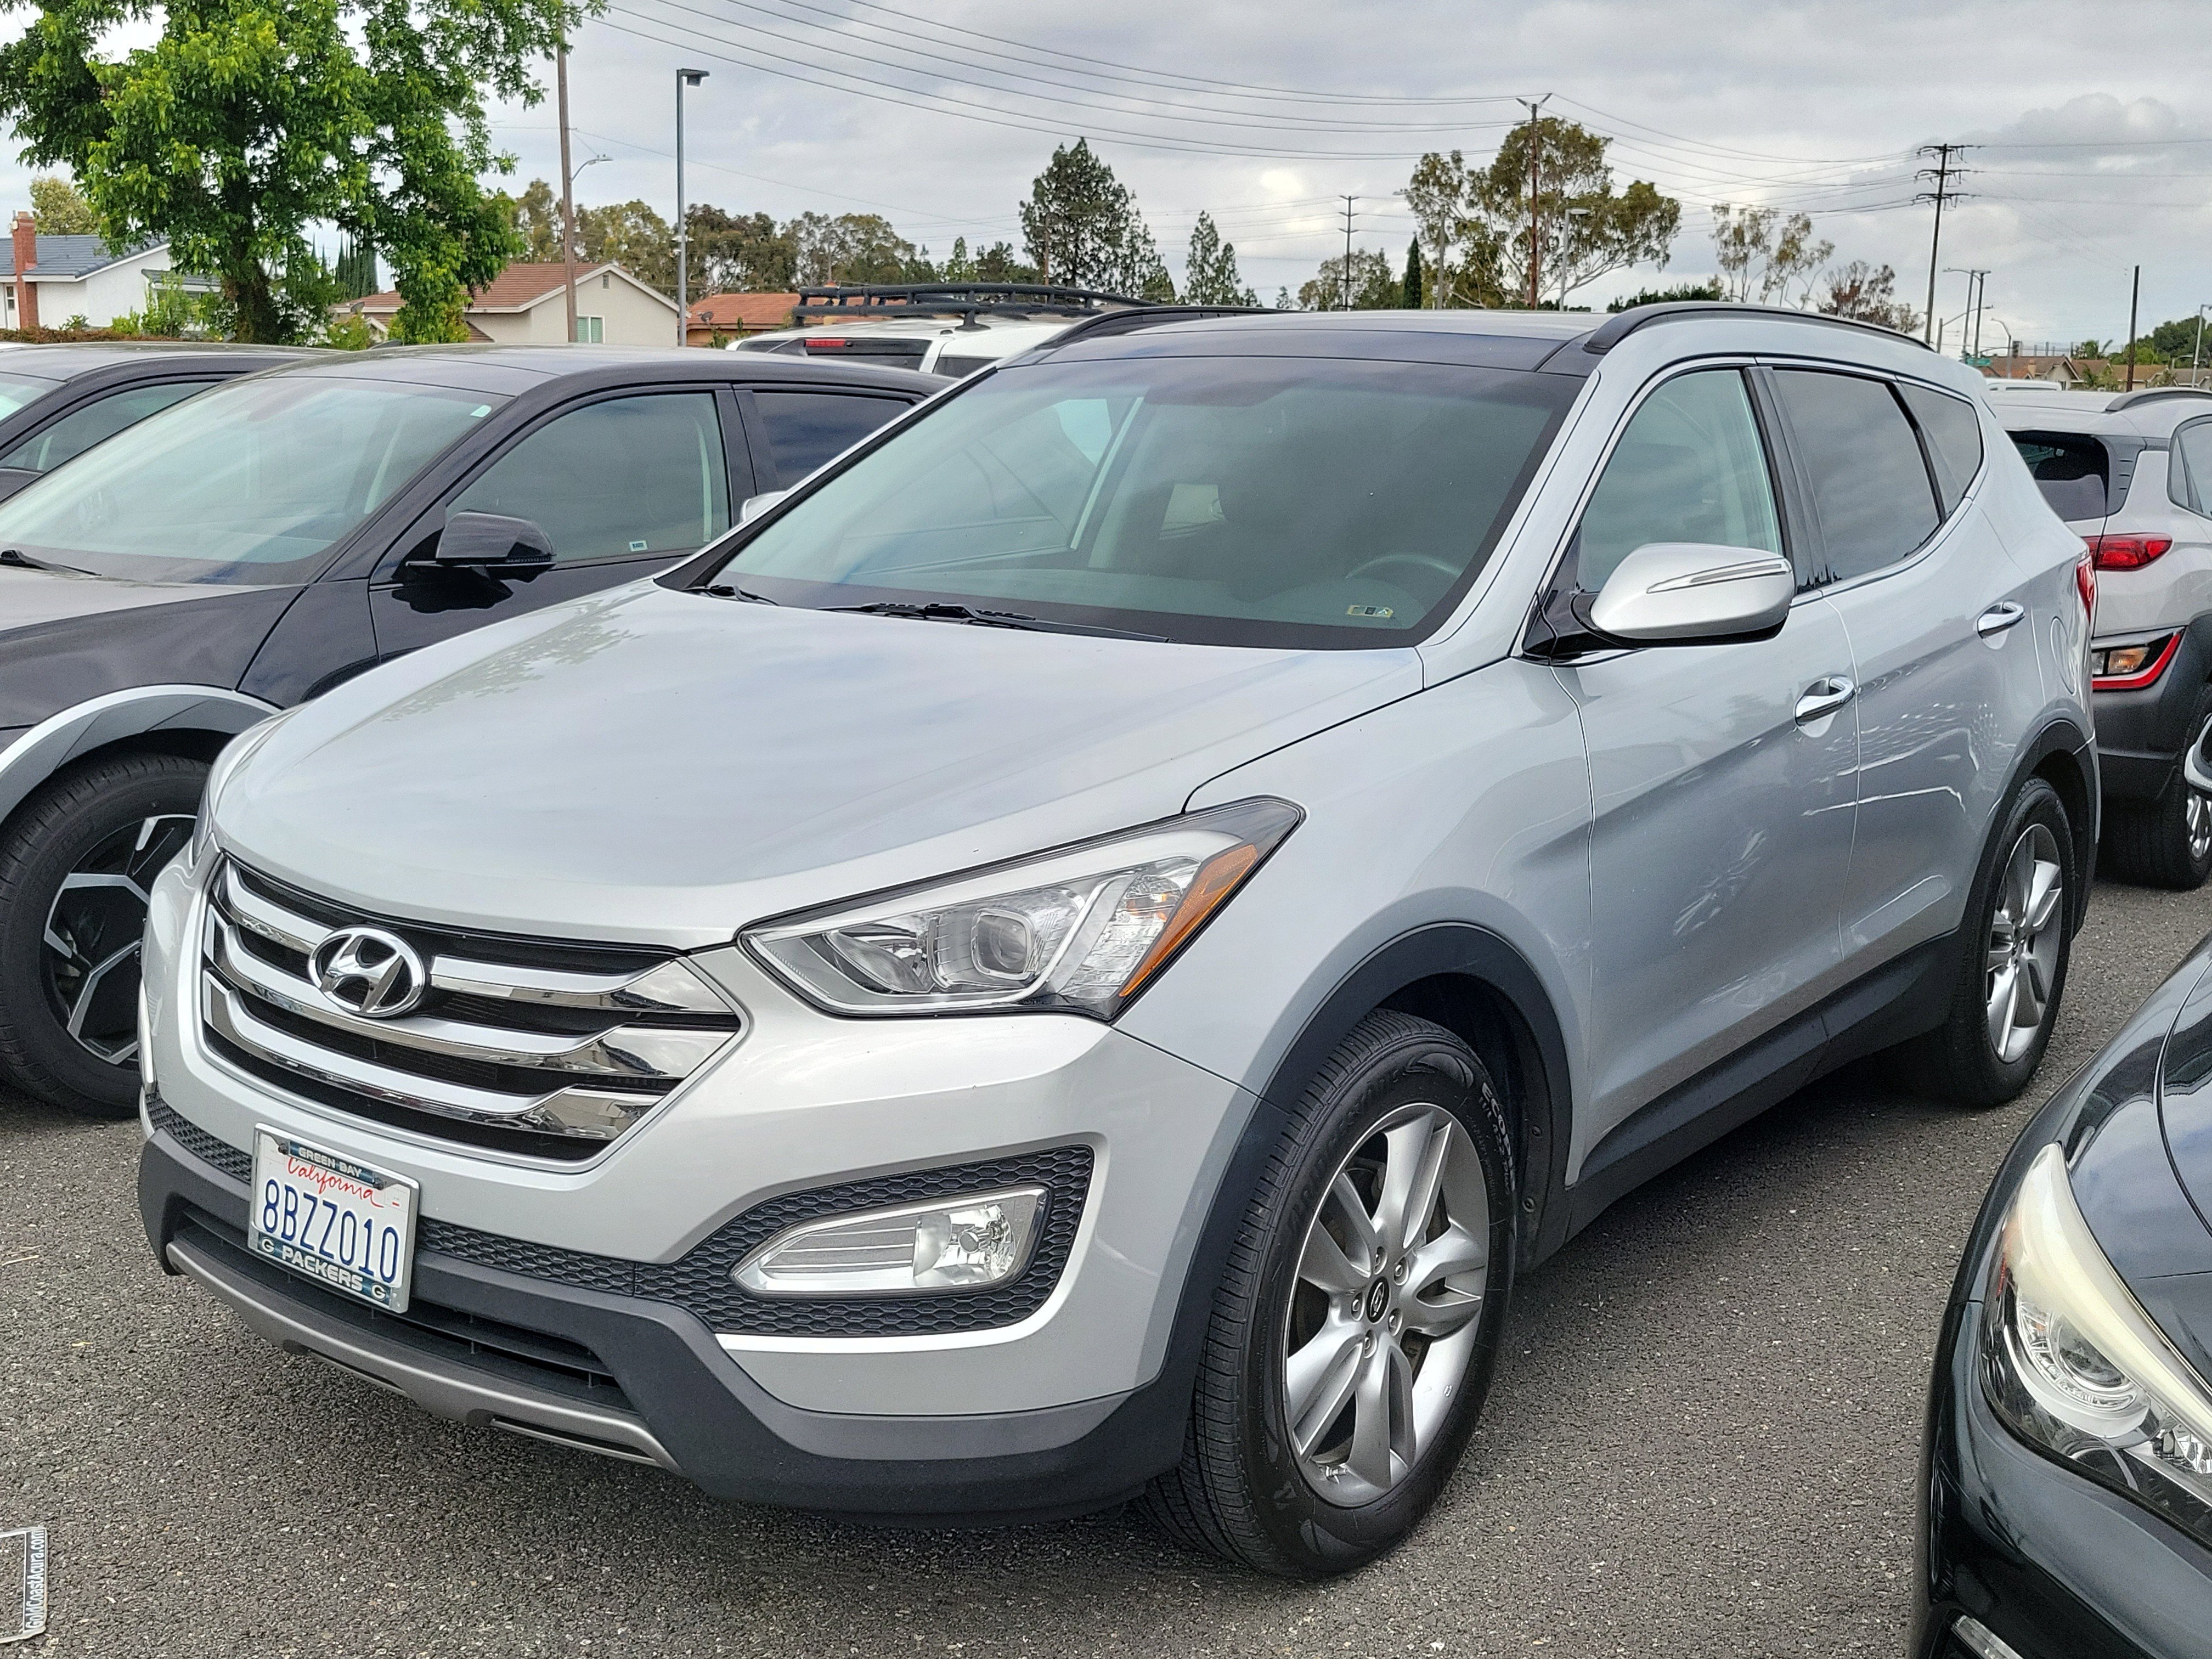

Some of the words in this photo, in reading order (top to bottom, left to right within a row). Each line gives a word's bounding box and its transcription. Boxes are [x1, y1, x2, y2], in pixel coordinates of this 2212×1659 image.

[287, 1156, 384, 1207] California
[299, 1147, 335, 1168] GREEN
[339, 1160, 362, 1178] BAY
[263, 1178, 399, 1283] 8BZZ010
[281, 1245, 364, 1291] PACKERS
[25, 1530, 45, 1629] GoldCoastAcura.com
